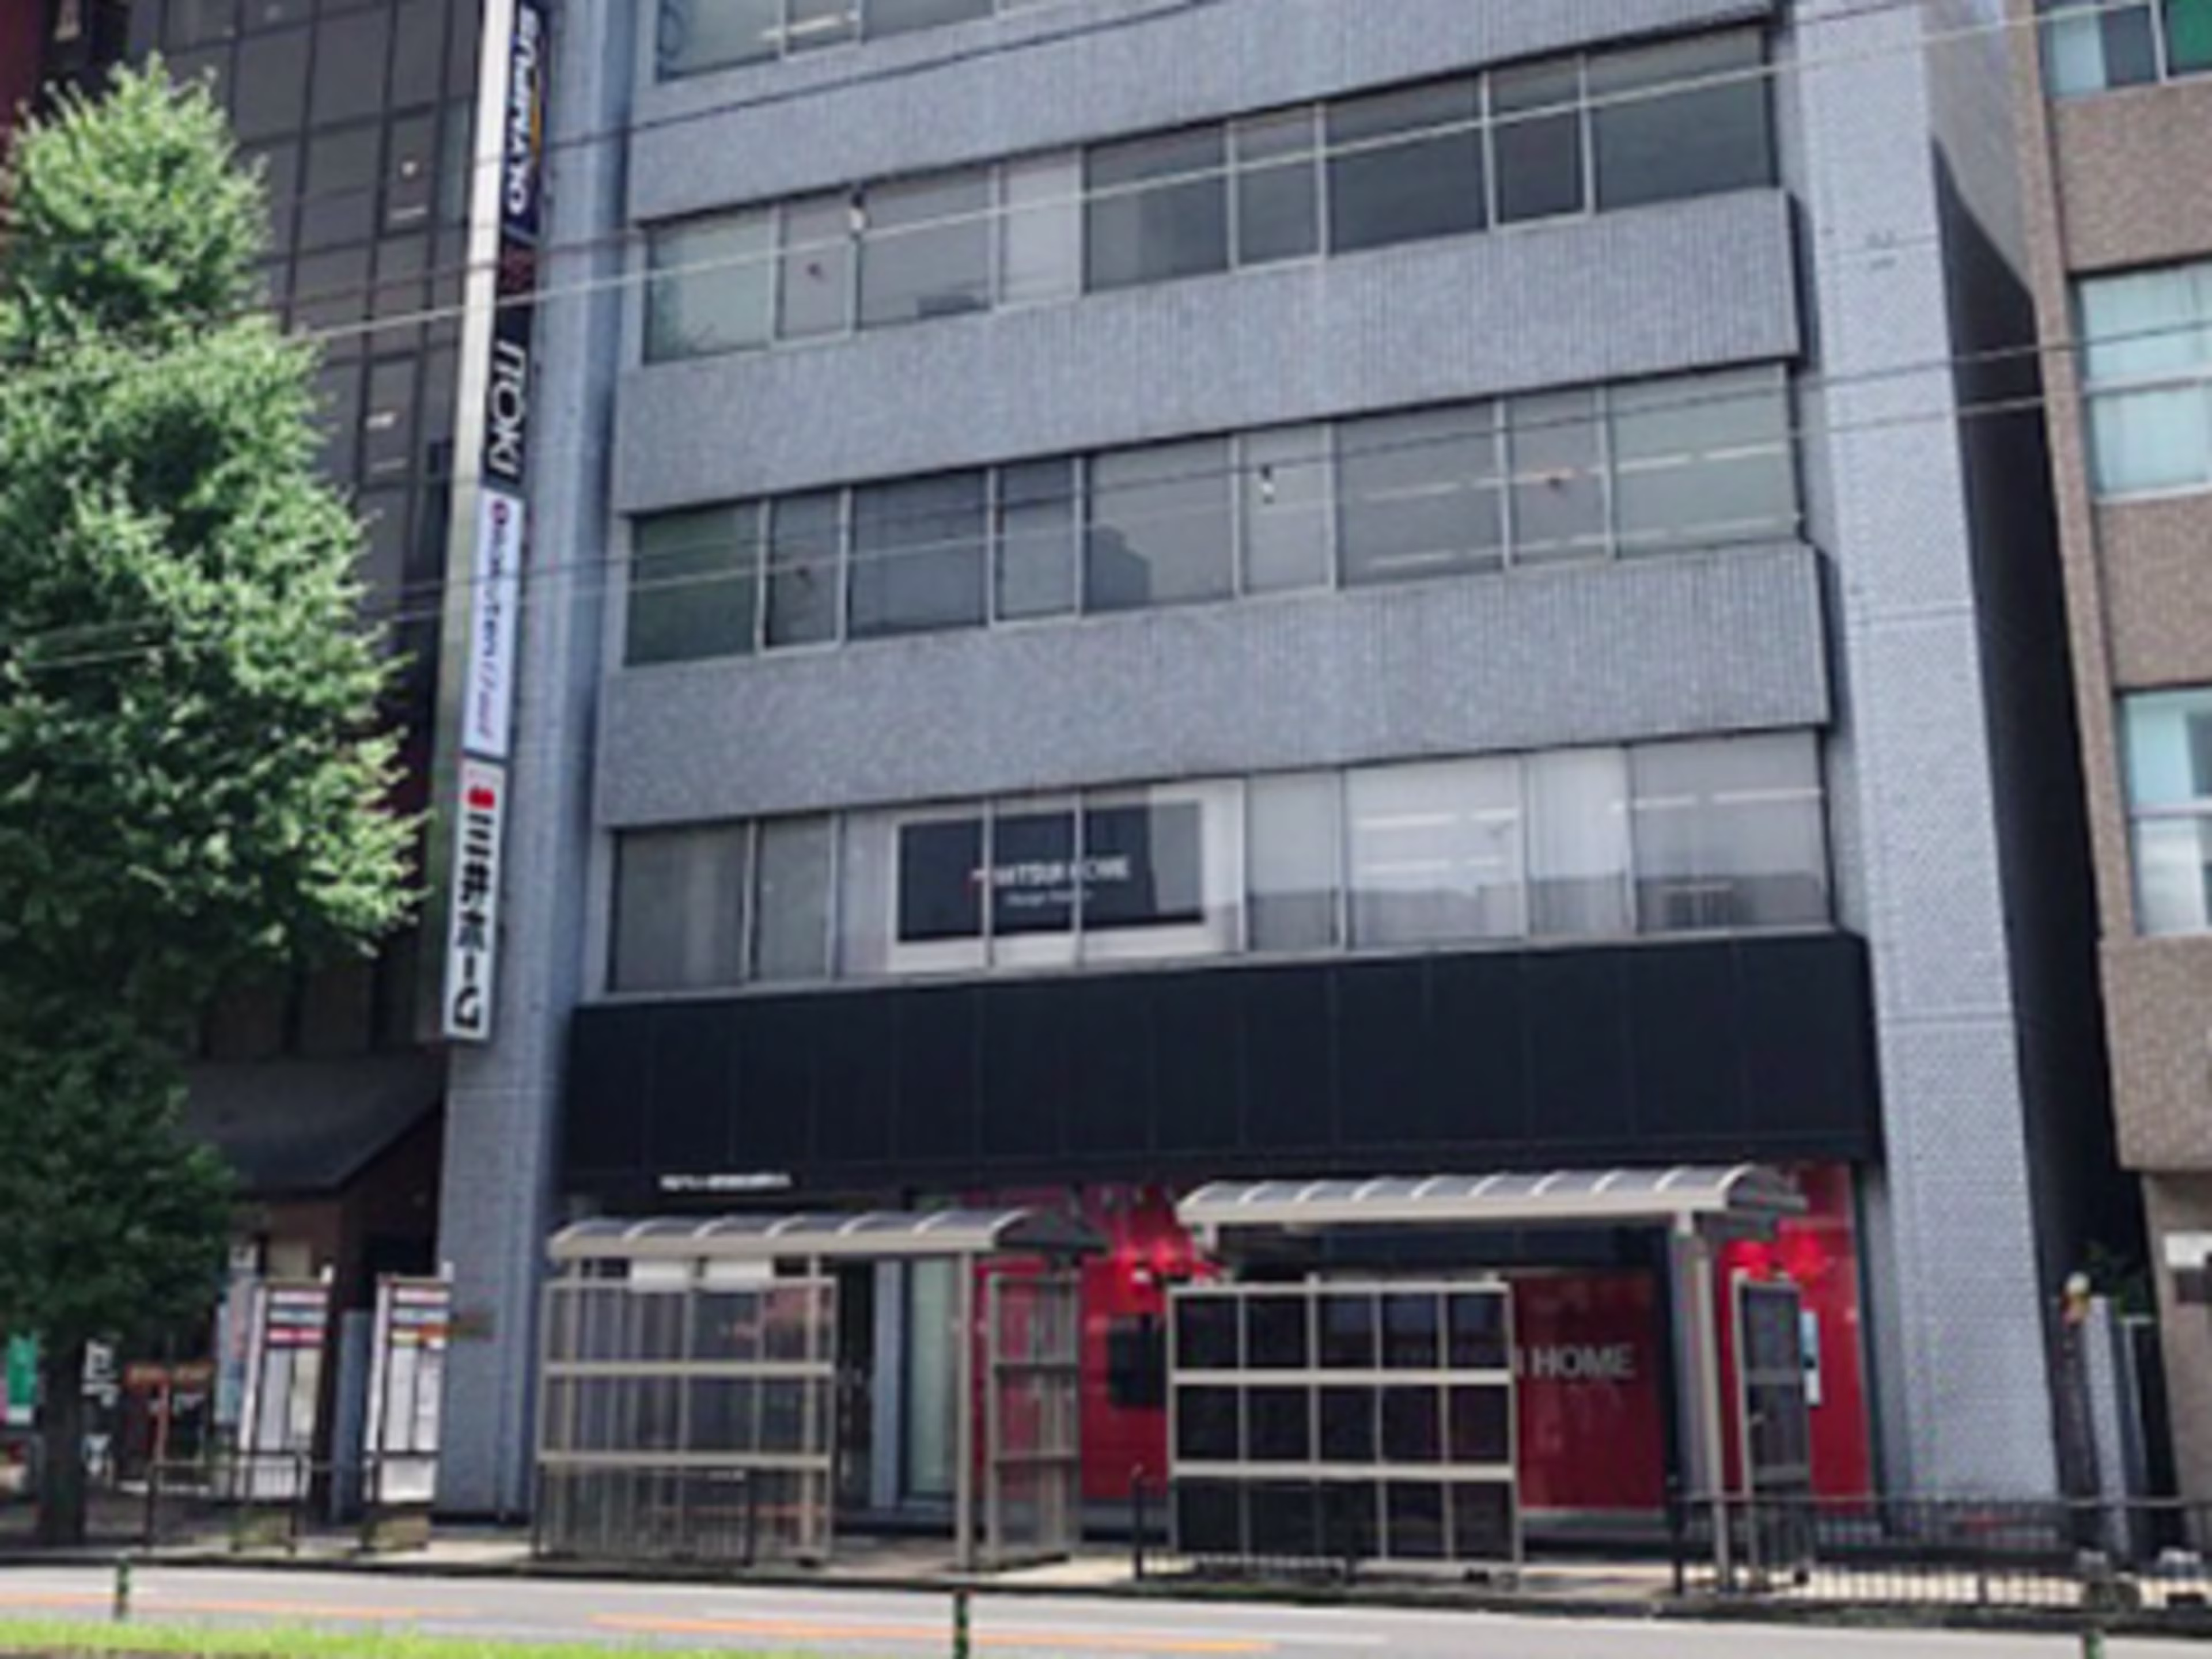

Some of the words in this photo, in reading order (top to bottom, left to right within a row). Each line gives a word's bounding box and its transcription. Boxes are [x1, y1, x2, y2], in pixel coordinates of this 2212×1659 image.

[490, 341, 524, 475] ITOKI
[453, 812, 494, 1029] 三井ホーム
[1532, 1342, 1637, 1379] HOME
